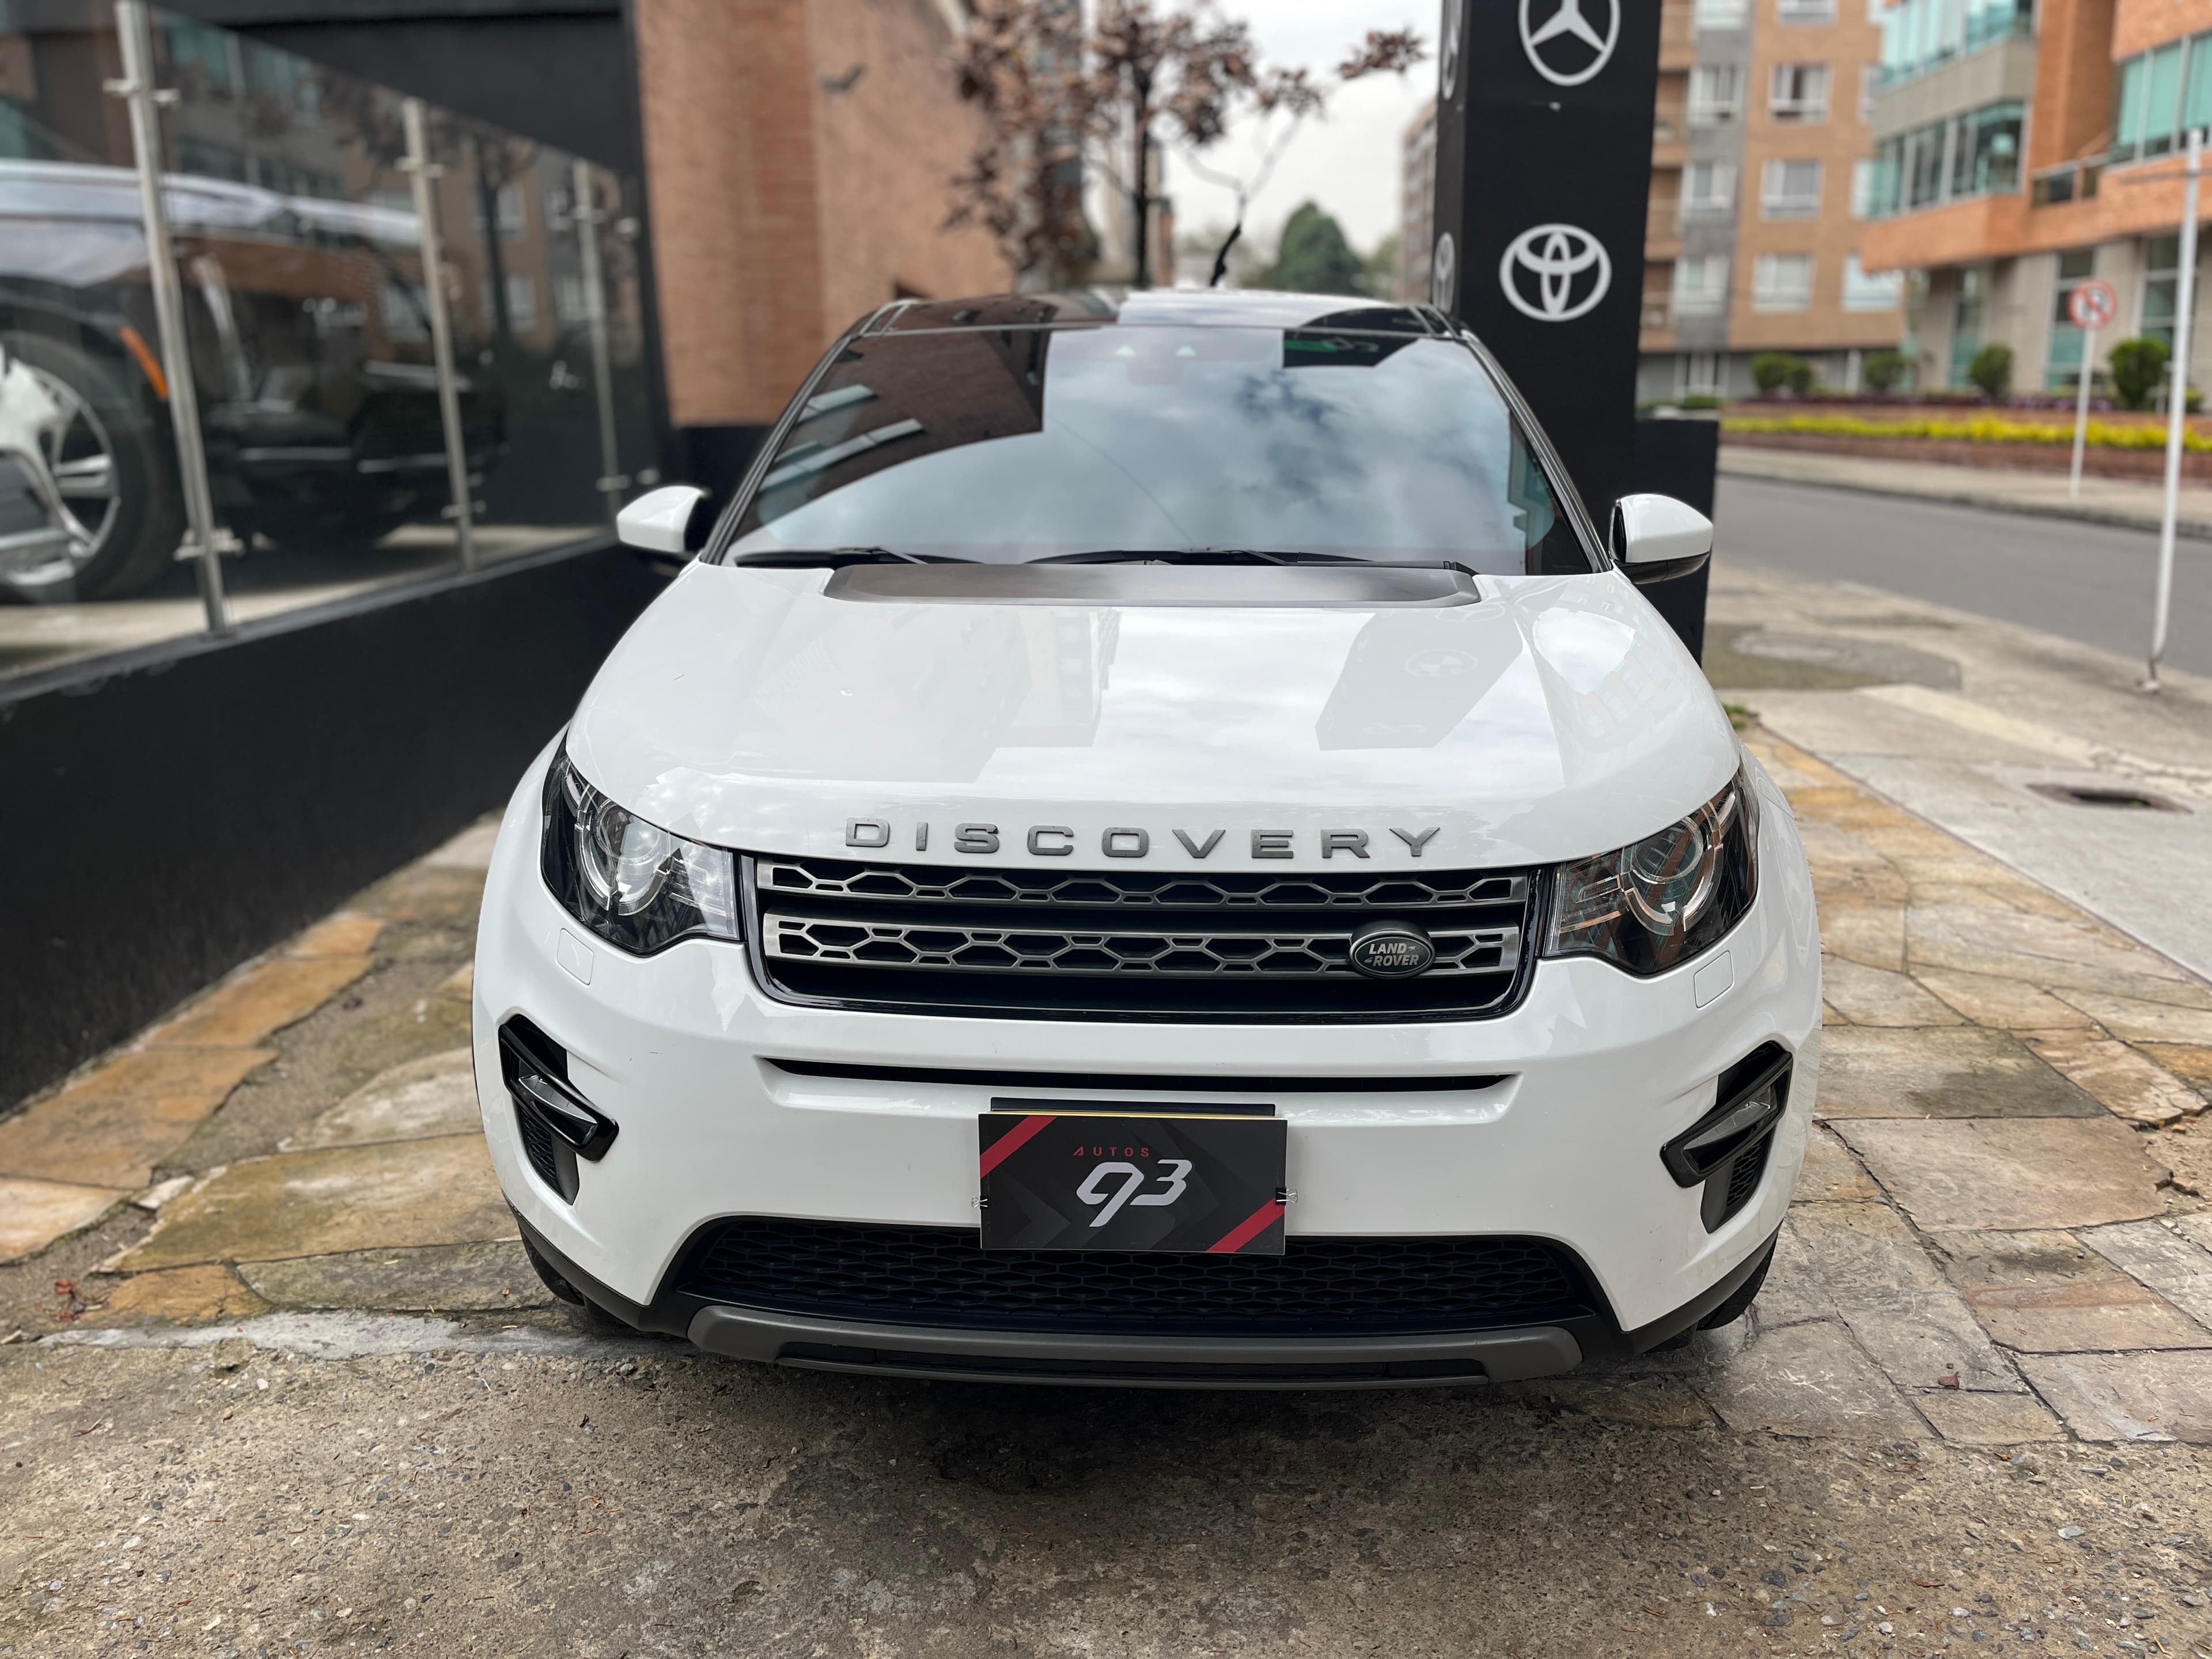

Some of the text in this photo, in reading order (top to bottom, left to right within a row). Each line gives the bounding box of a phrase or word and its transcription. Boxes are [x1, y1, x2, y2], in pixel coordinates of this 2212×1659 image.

[846, 817, 1441, 859] DISCOVERY
[1369, 943, 1407, 955] LAND
[1373, 955, 1419, 967] ROVER
[1073, 1146, 1150, 1157] AUTOS
[1076, 1159, 1193, 1227] 93
